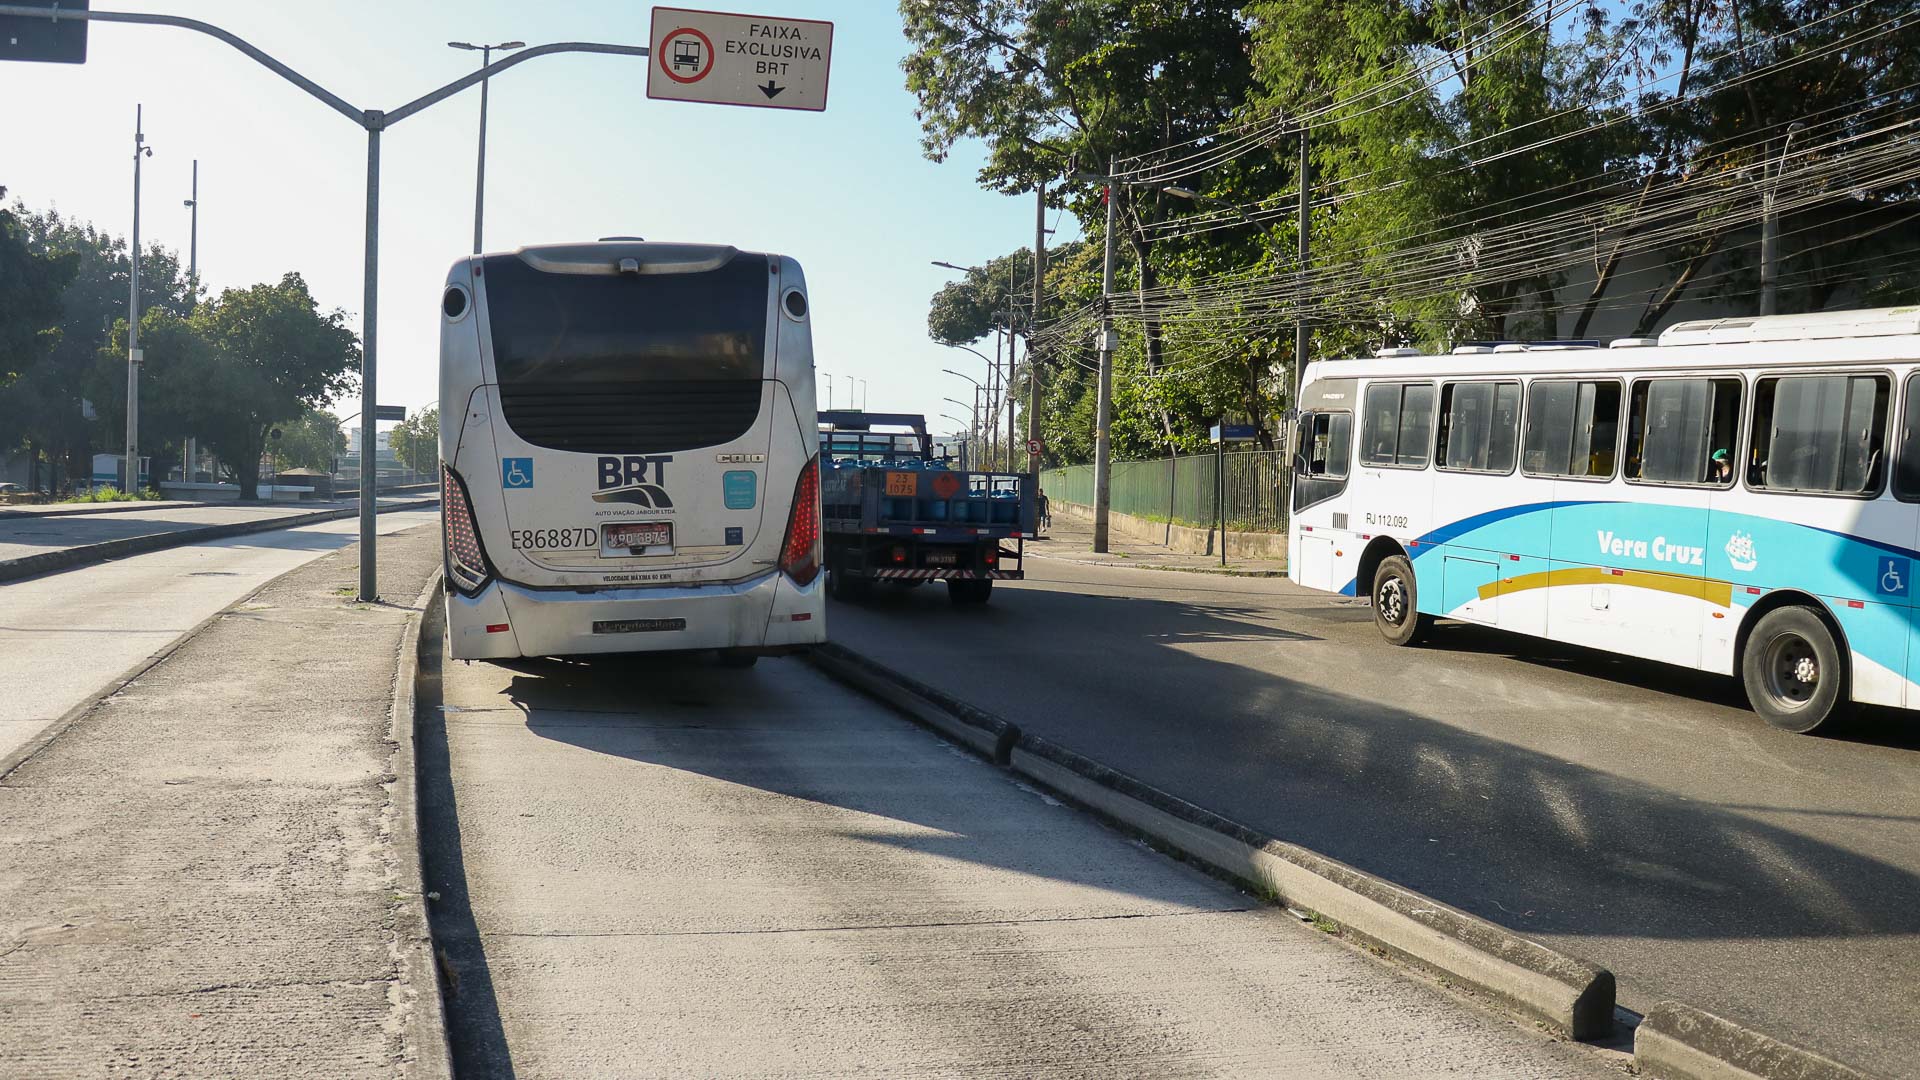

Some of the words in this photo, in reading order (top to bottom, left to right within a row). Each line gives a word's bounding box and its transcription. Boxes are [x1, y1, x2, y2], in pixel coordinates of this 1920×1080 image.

[750, 24, 801, 40] FAIXA
[725, 40, 822, 61] EXCLUSIVA
[756, 61, 789, 76] BRT
[597, 455, 673, 490] BRT
[895, 474, 908, 483] 23
[889, 484, 913, 494] 1075
[613, 509, 635, 517] VIAÇÃO
[1366, 512, 1376, 525] RJ
[1378, 514, 1408, 529] 112.092
[511, 528, 598, 550] E86887D
[1597, 530, 1648, 559] Vera
[1652, 536, 1705, 566] Cruz
[631, 573, 651, 581] MÁXIMA
